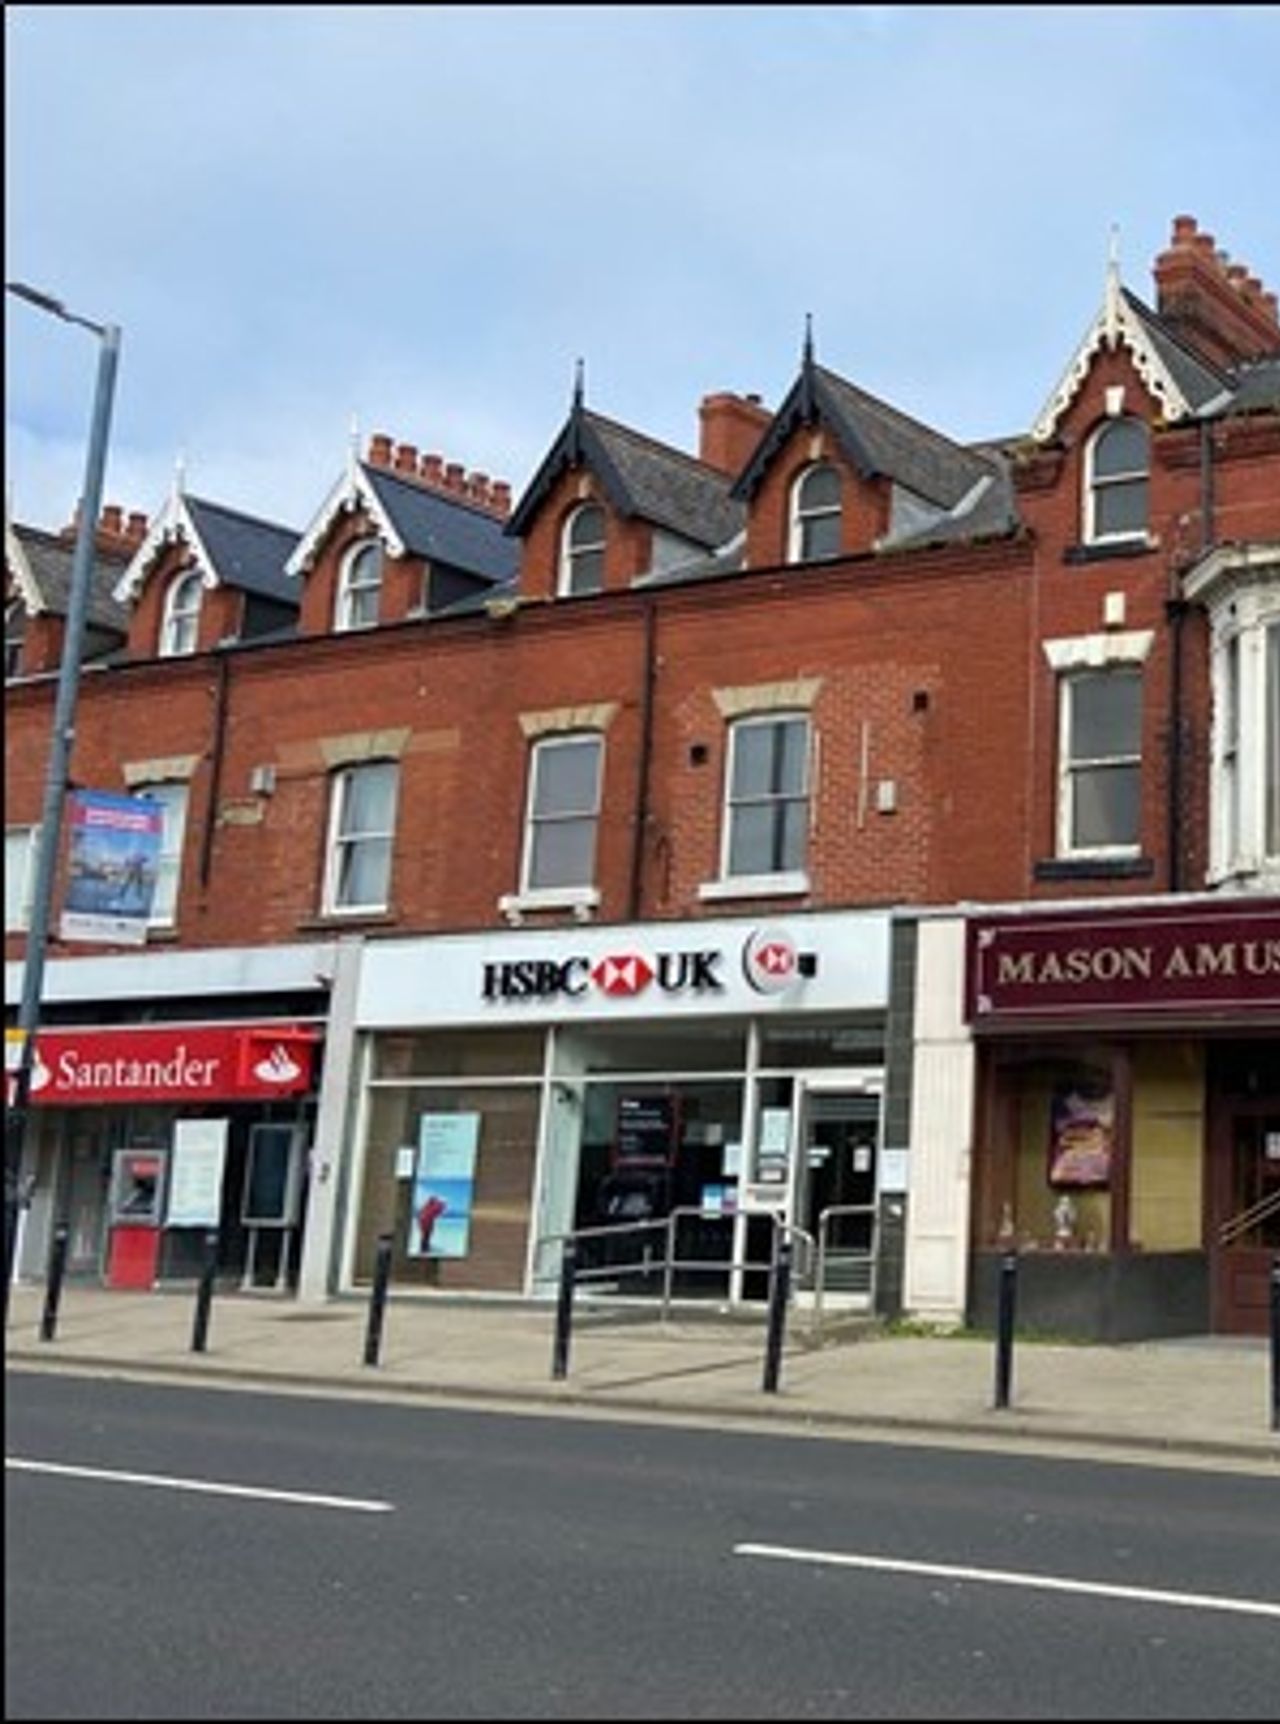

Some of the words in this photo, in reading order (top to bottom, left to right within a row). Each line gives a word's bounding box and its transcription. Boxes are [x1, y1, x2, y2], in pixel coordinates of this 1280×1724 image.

[482, 957, 591, 998] HSBC
[657, 951, 724, 990] UK
[999, 947, 1152, 984] MASON
[56, 1045, 219, 1089] Santander
